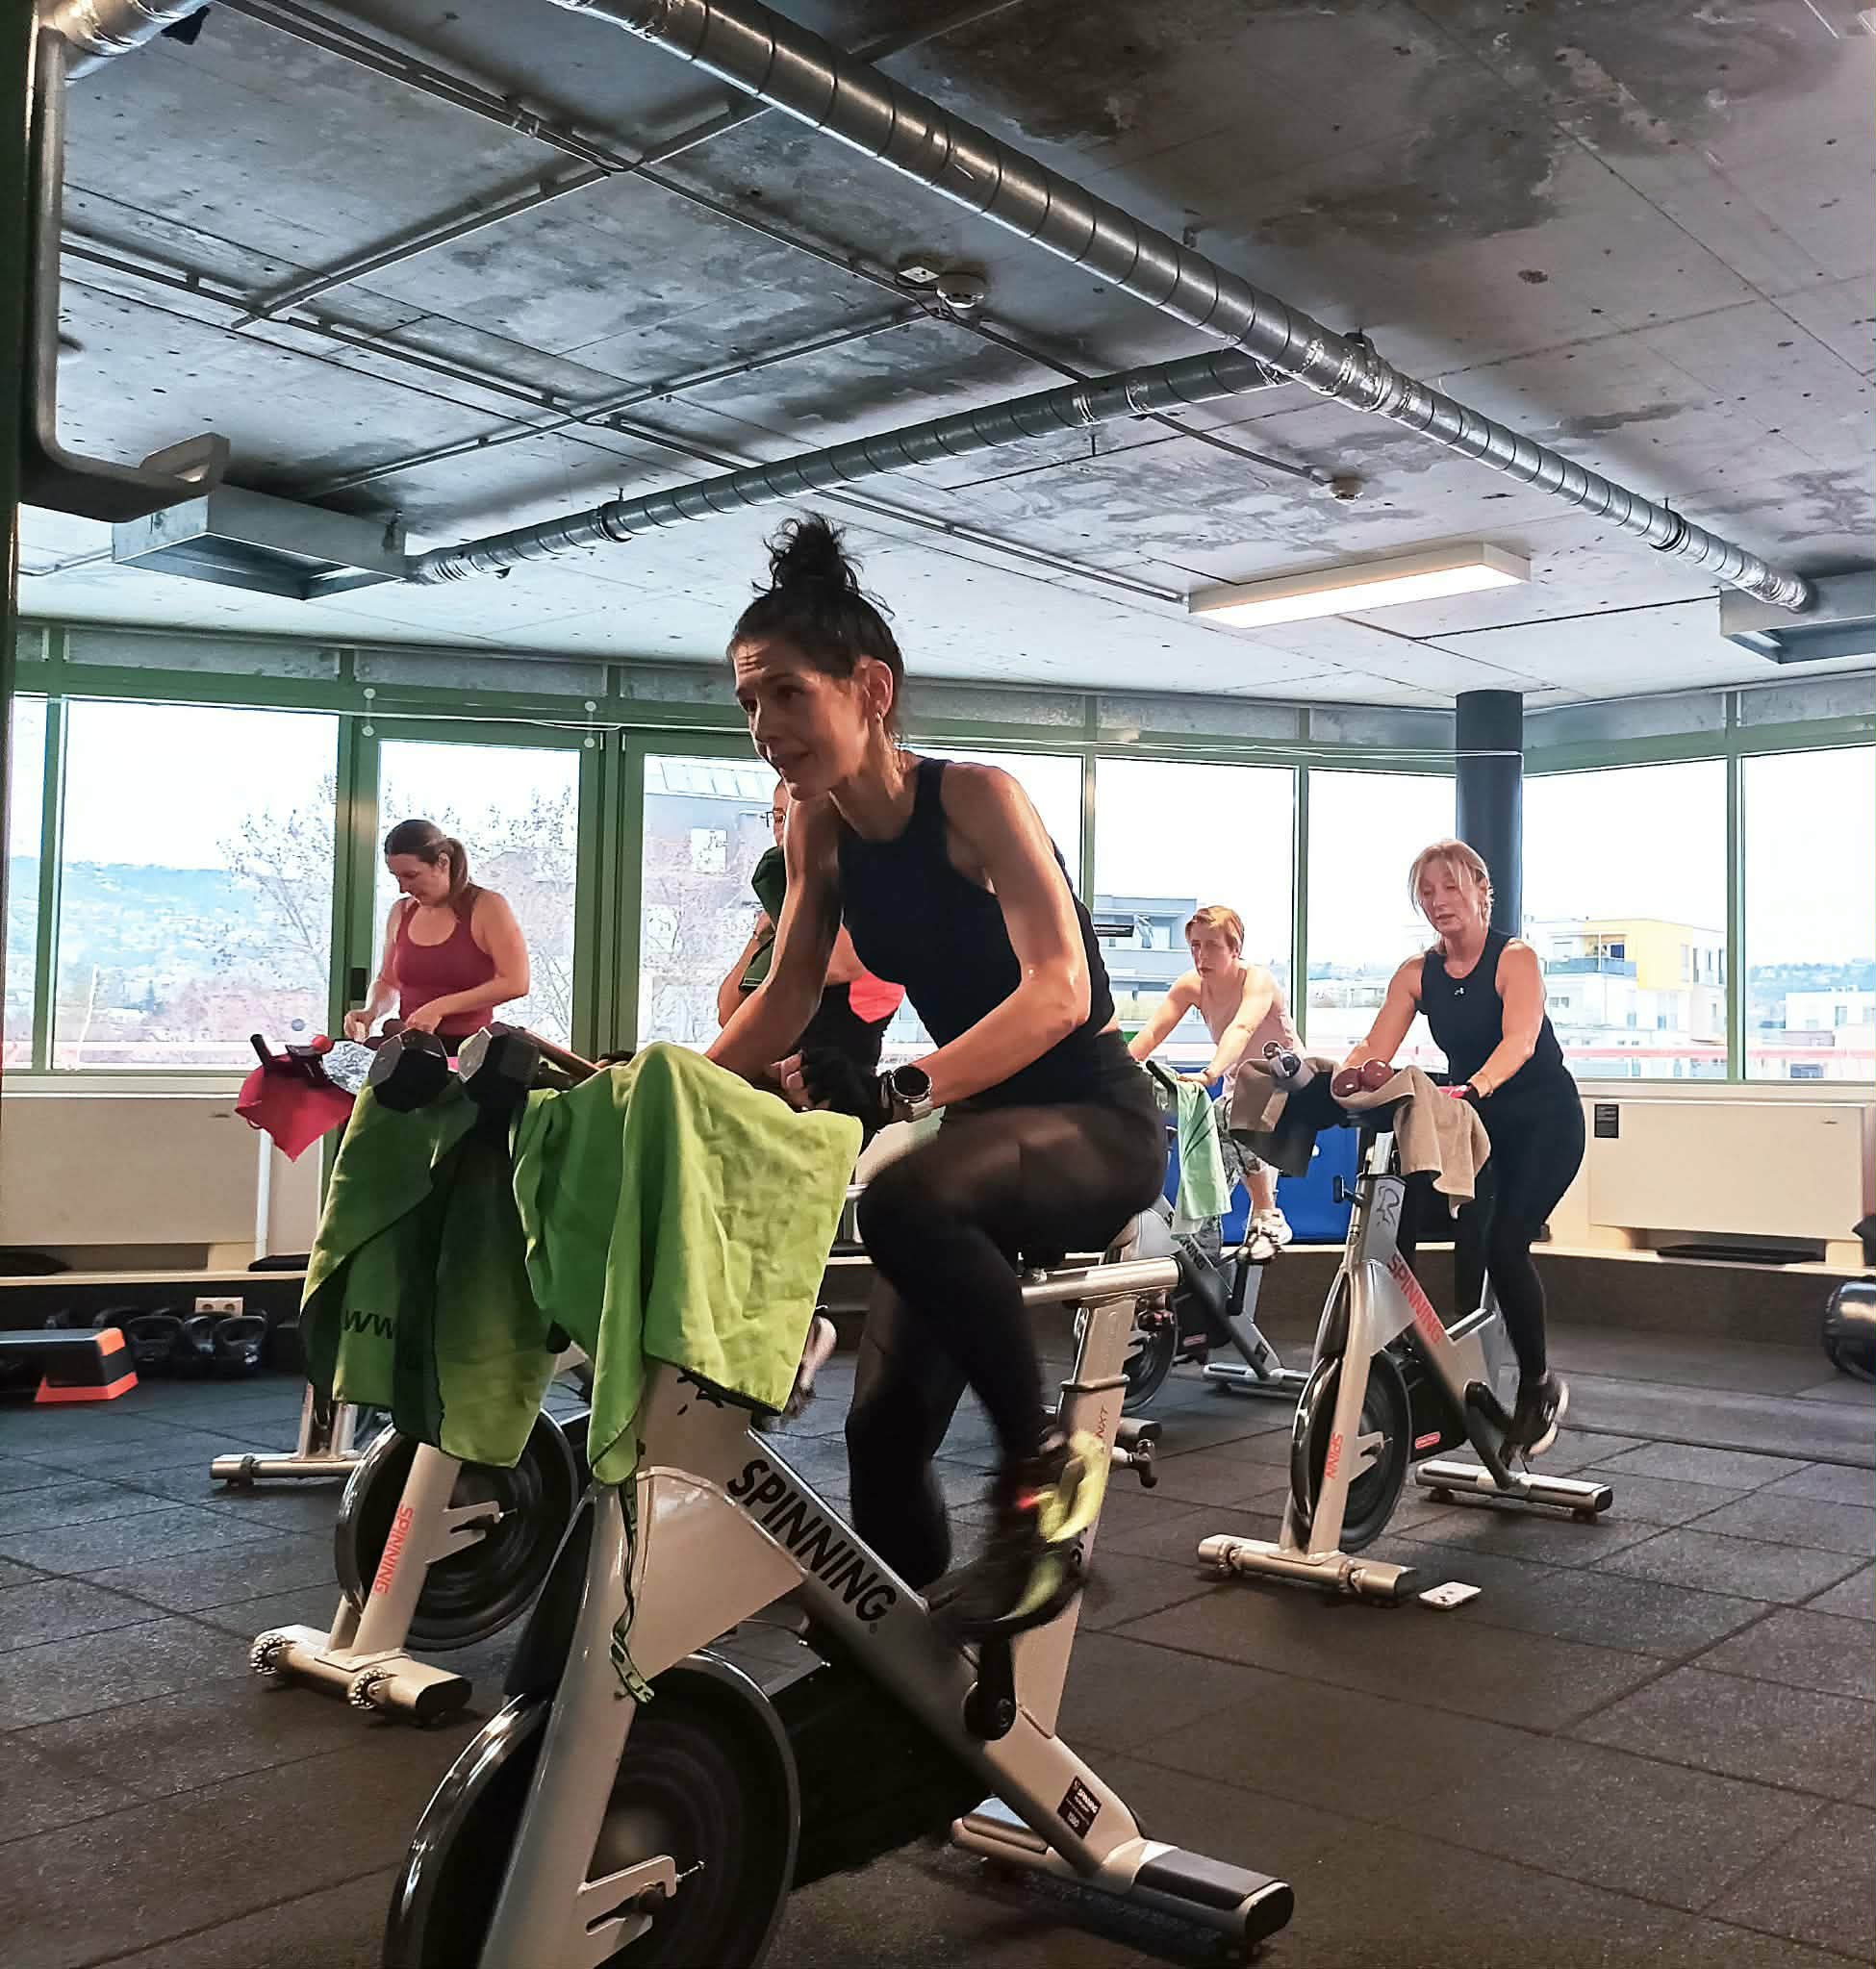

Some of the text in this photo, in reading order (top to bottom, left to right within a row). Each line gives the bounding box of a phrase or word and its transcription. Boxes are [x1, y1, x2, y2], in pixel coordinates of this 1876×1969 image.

[1387, 1252, 1444, 1344] SPINNING
[373, 1506, 414, 1594] SPINNING
[726, 1458, 897, 1622] SPINNING
